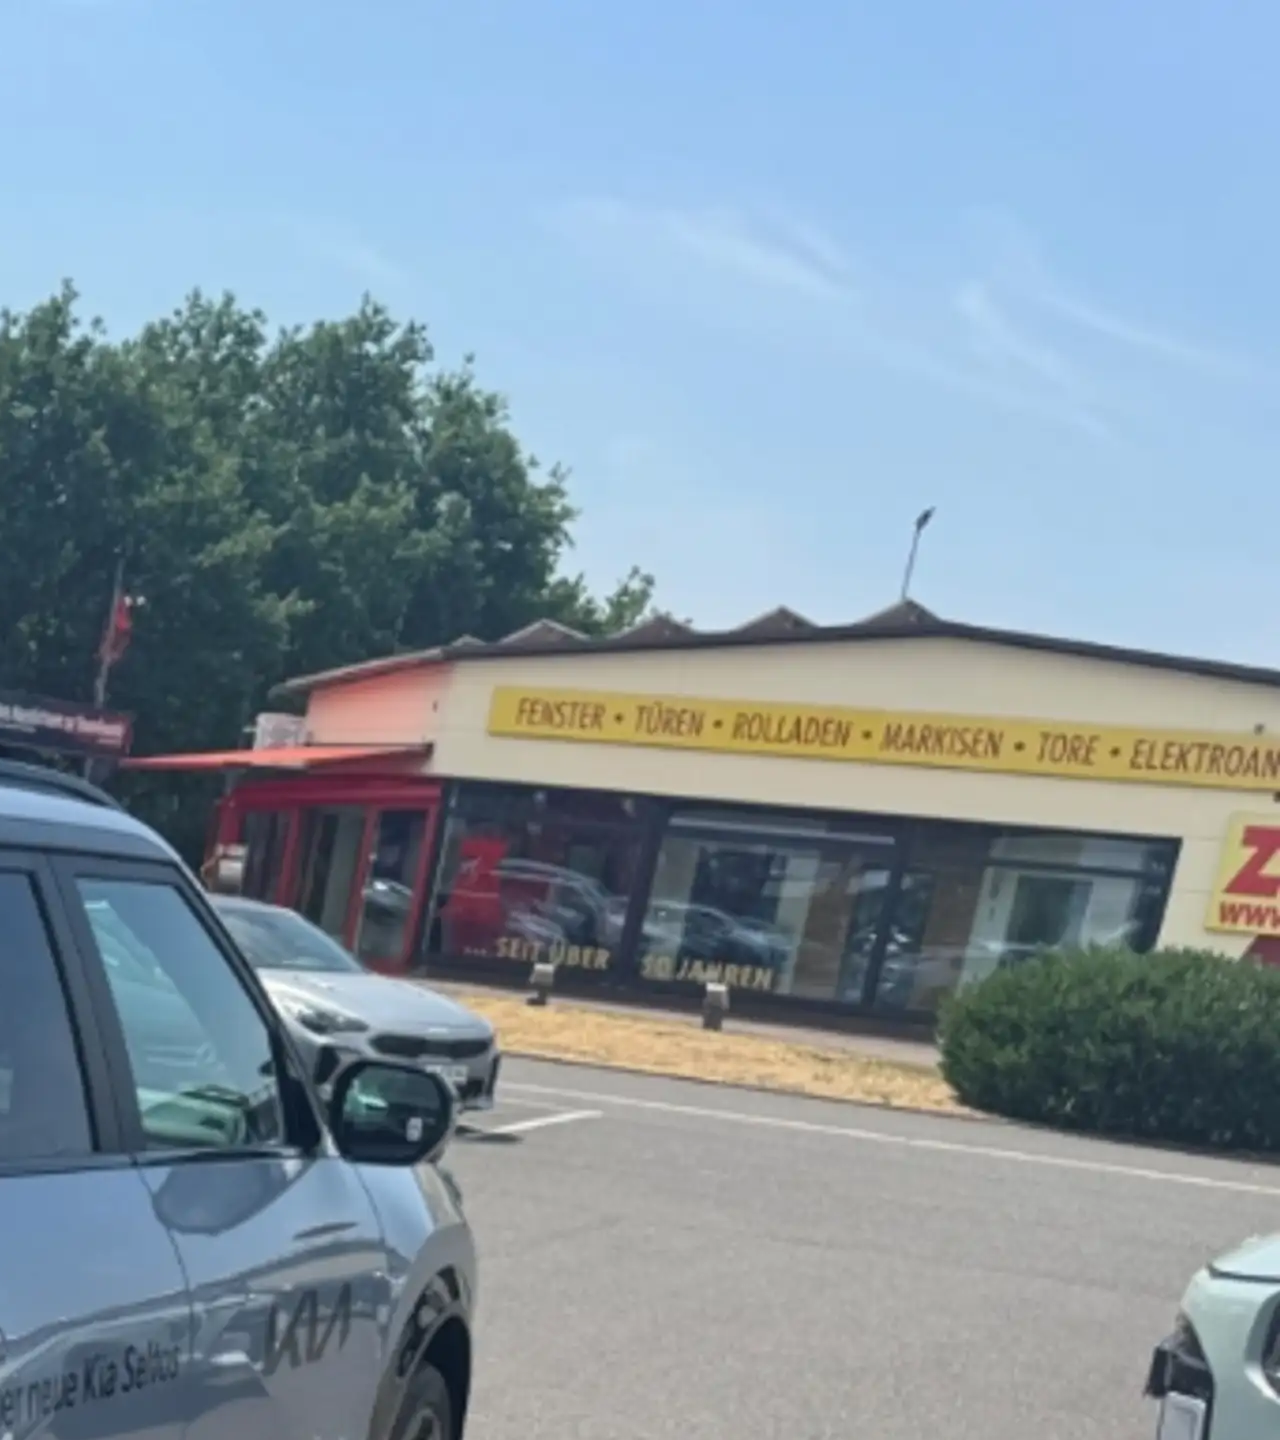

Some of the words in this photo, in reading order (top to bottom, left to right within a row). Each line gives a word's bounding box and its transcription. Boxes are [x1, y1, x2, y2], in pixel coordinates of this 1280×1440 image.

[515, 697, 606, 730] FENSTER
[635, 701, 705, 736] TÜREN
[731, 712, 853, 747] ROLLADEN
[878, 722, 1004, 759] MARKISEN
[1037, 731, 1100, 766] TORE
[83, 1352, 118, 1405] Kia
